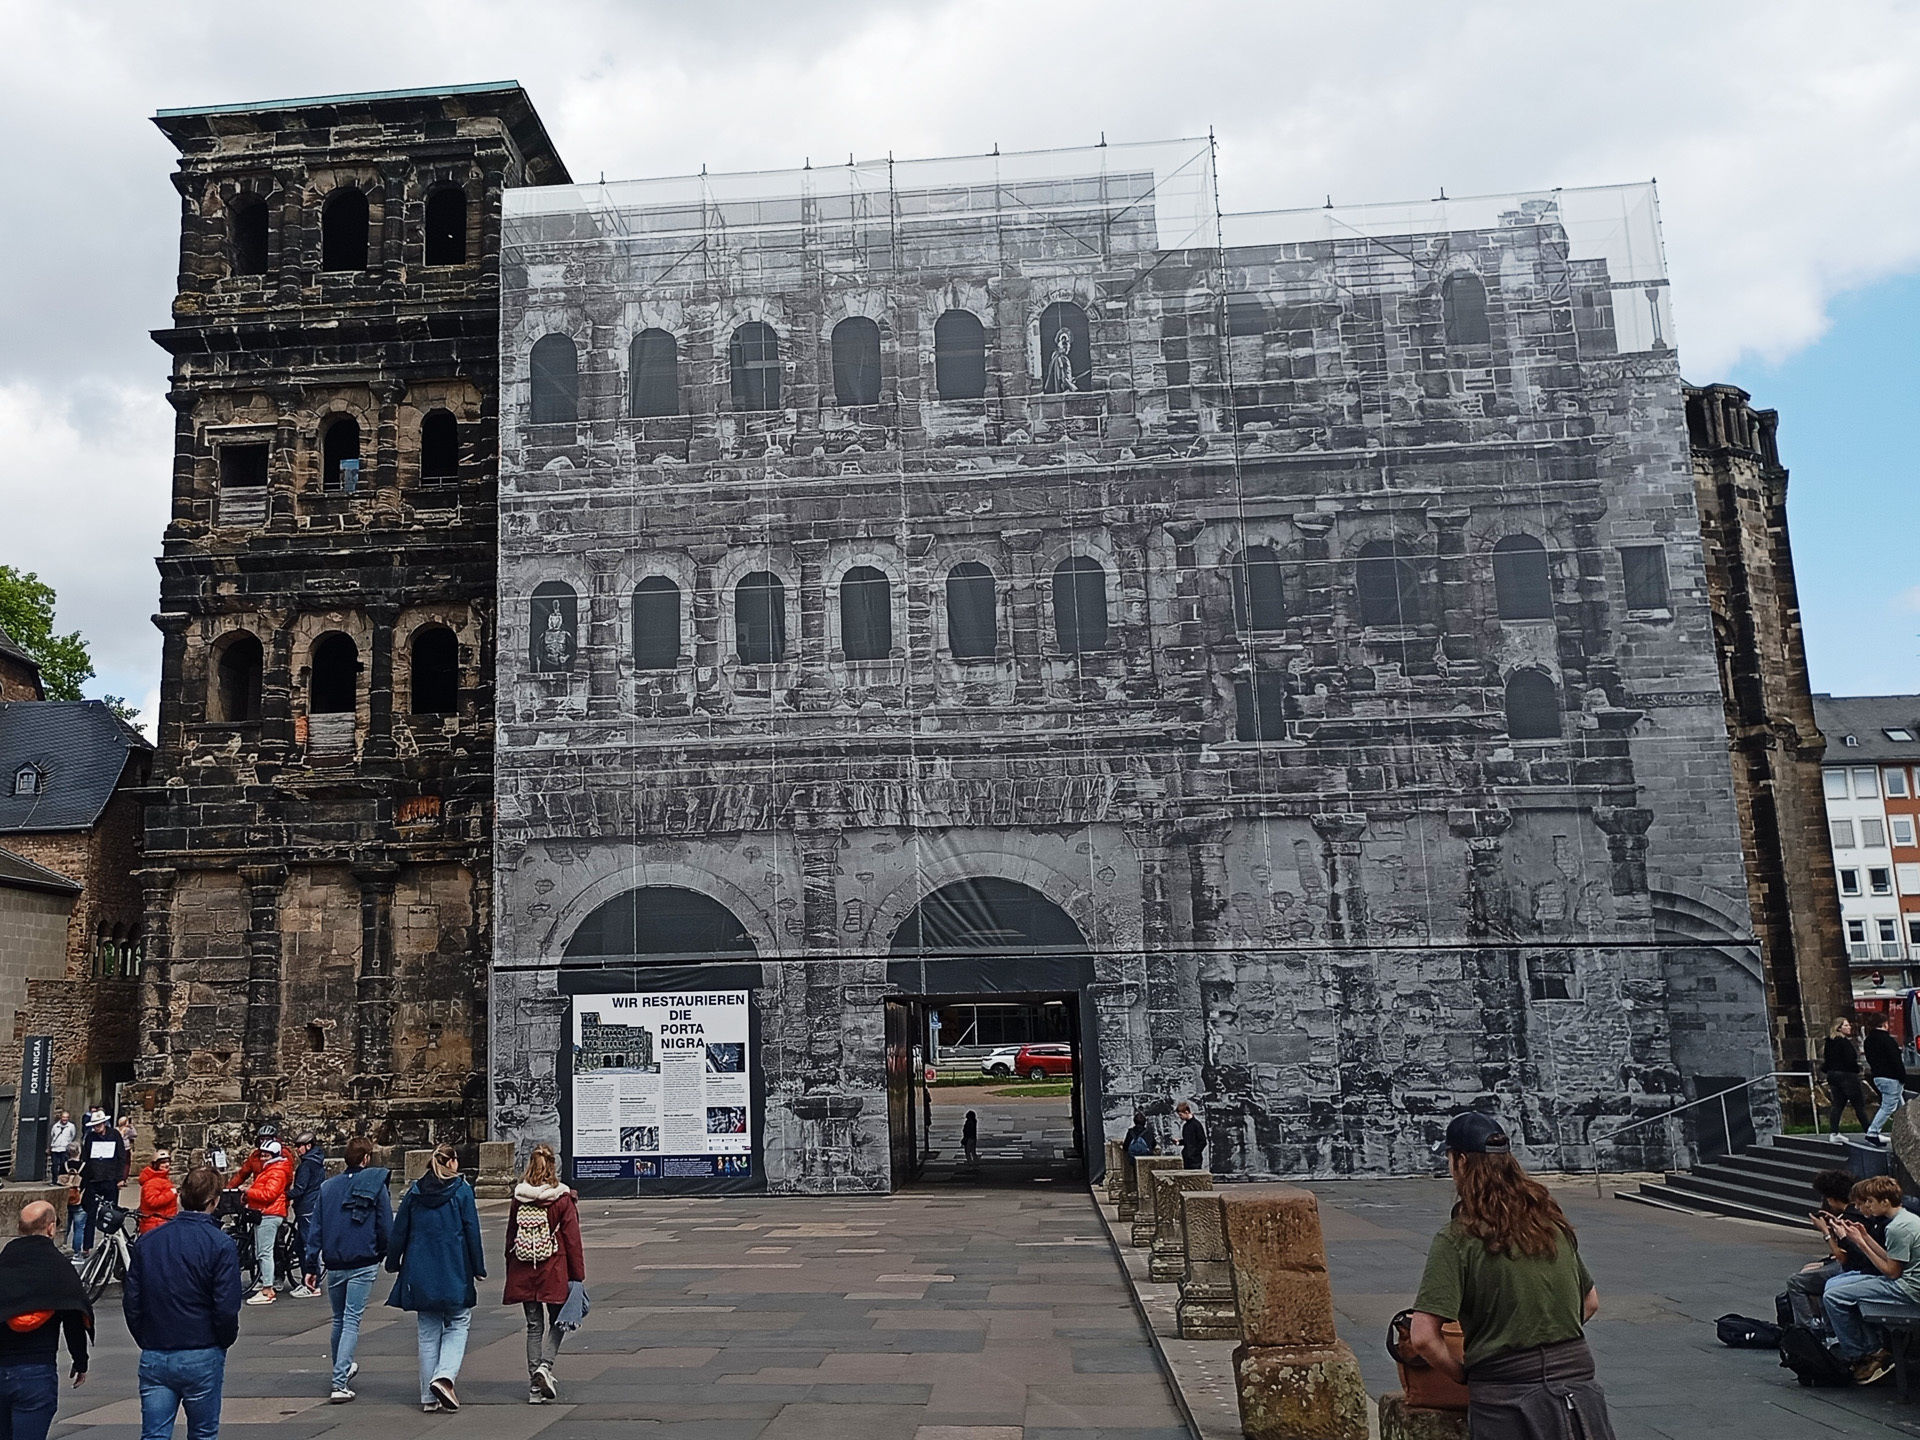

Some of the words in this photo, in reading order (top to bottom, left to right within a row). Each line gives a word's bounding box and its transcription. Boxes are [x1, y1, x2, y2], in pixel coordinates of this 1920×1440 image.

[612, 997, 638, 1008] WIR
[642, 995, 745, 1008] RESTAURIEREN
[669, 1010, 691, 1020] DIE
[660, 1023, 704, 1035] PORTA
[661, 1038, 705, 1049] NIGRA
[32, 1039, 41, 1066] NIGRA
[30, 1067, 39, 1094] PORTA
